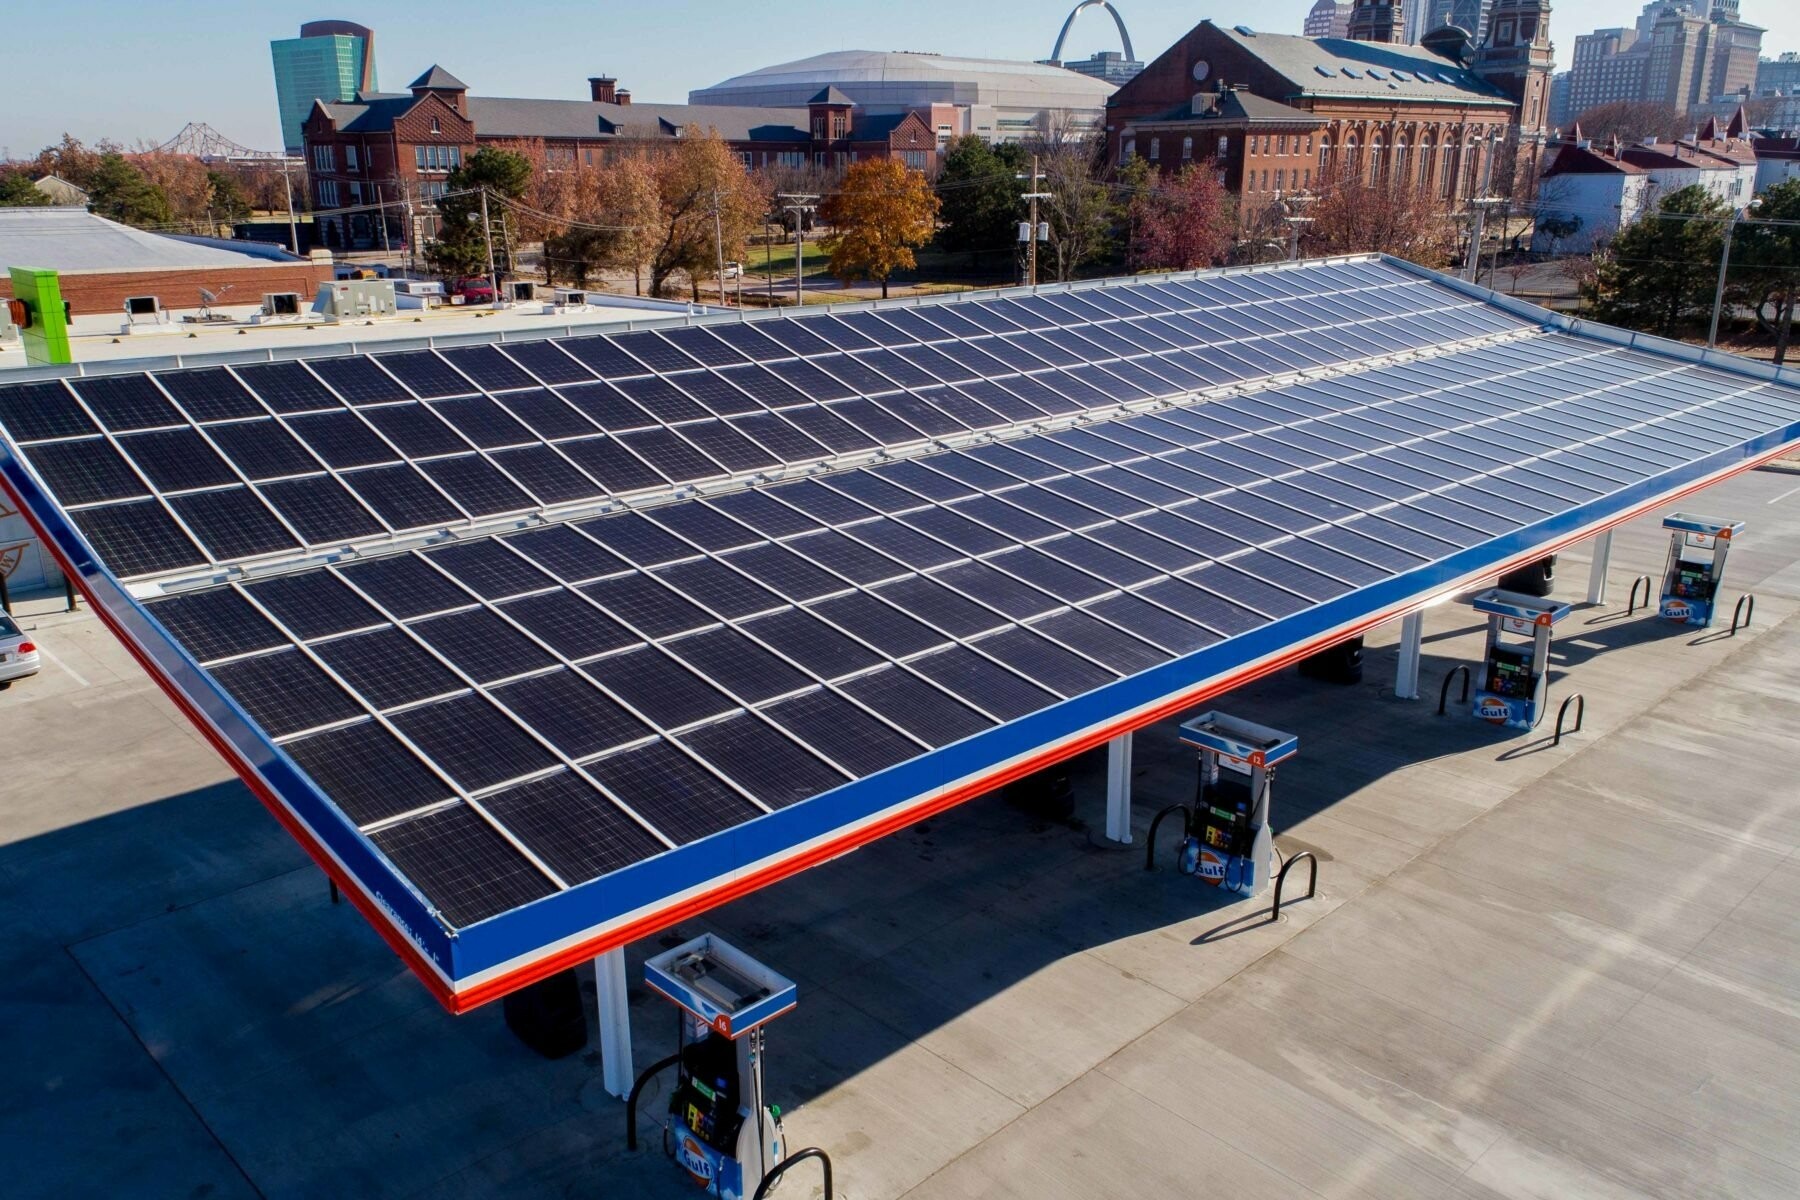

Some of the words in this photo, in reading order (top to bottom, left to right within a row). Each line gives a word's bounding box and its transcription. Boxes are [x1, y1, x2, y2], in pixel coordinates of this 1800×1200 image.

[1664, 609, 1690, 617] Gulf
[1480, 707, 1509, 718] Gulf
[1253, 755, 1261, 765] 12
[719, 1018, 727, 1031] 16
[683, 1150, 710, 1177] Gulf
